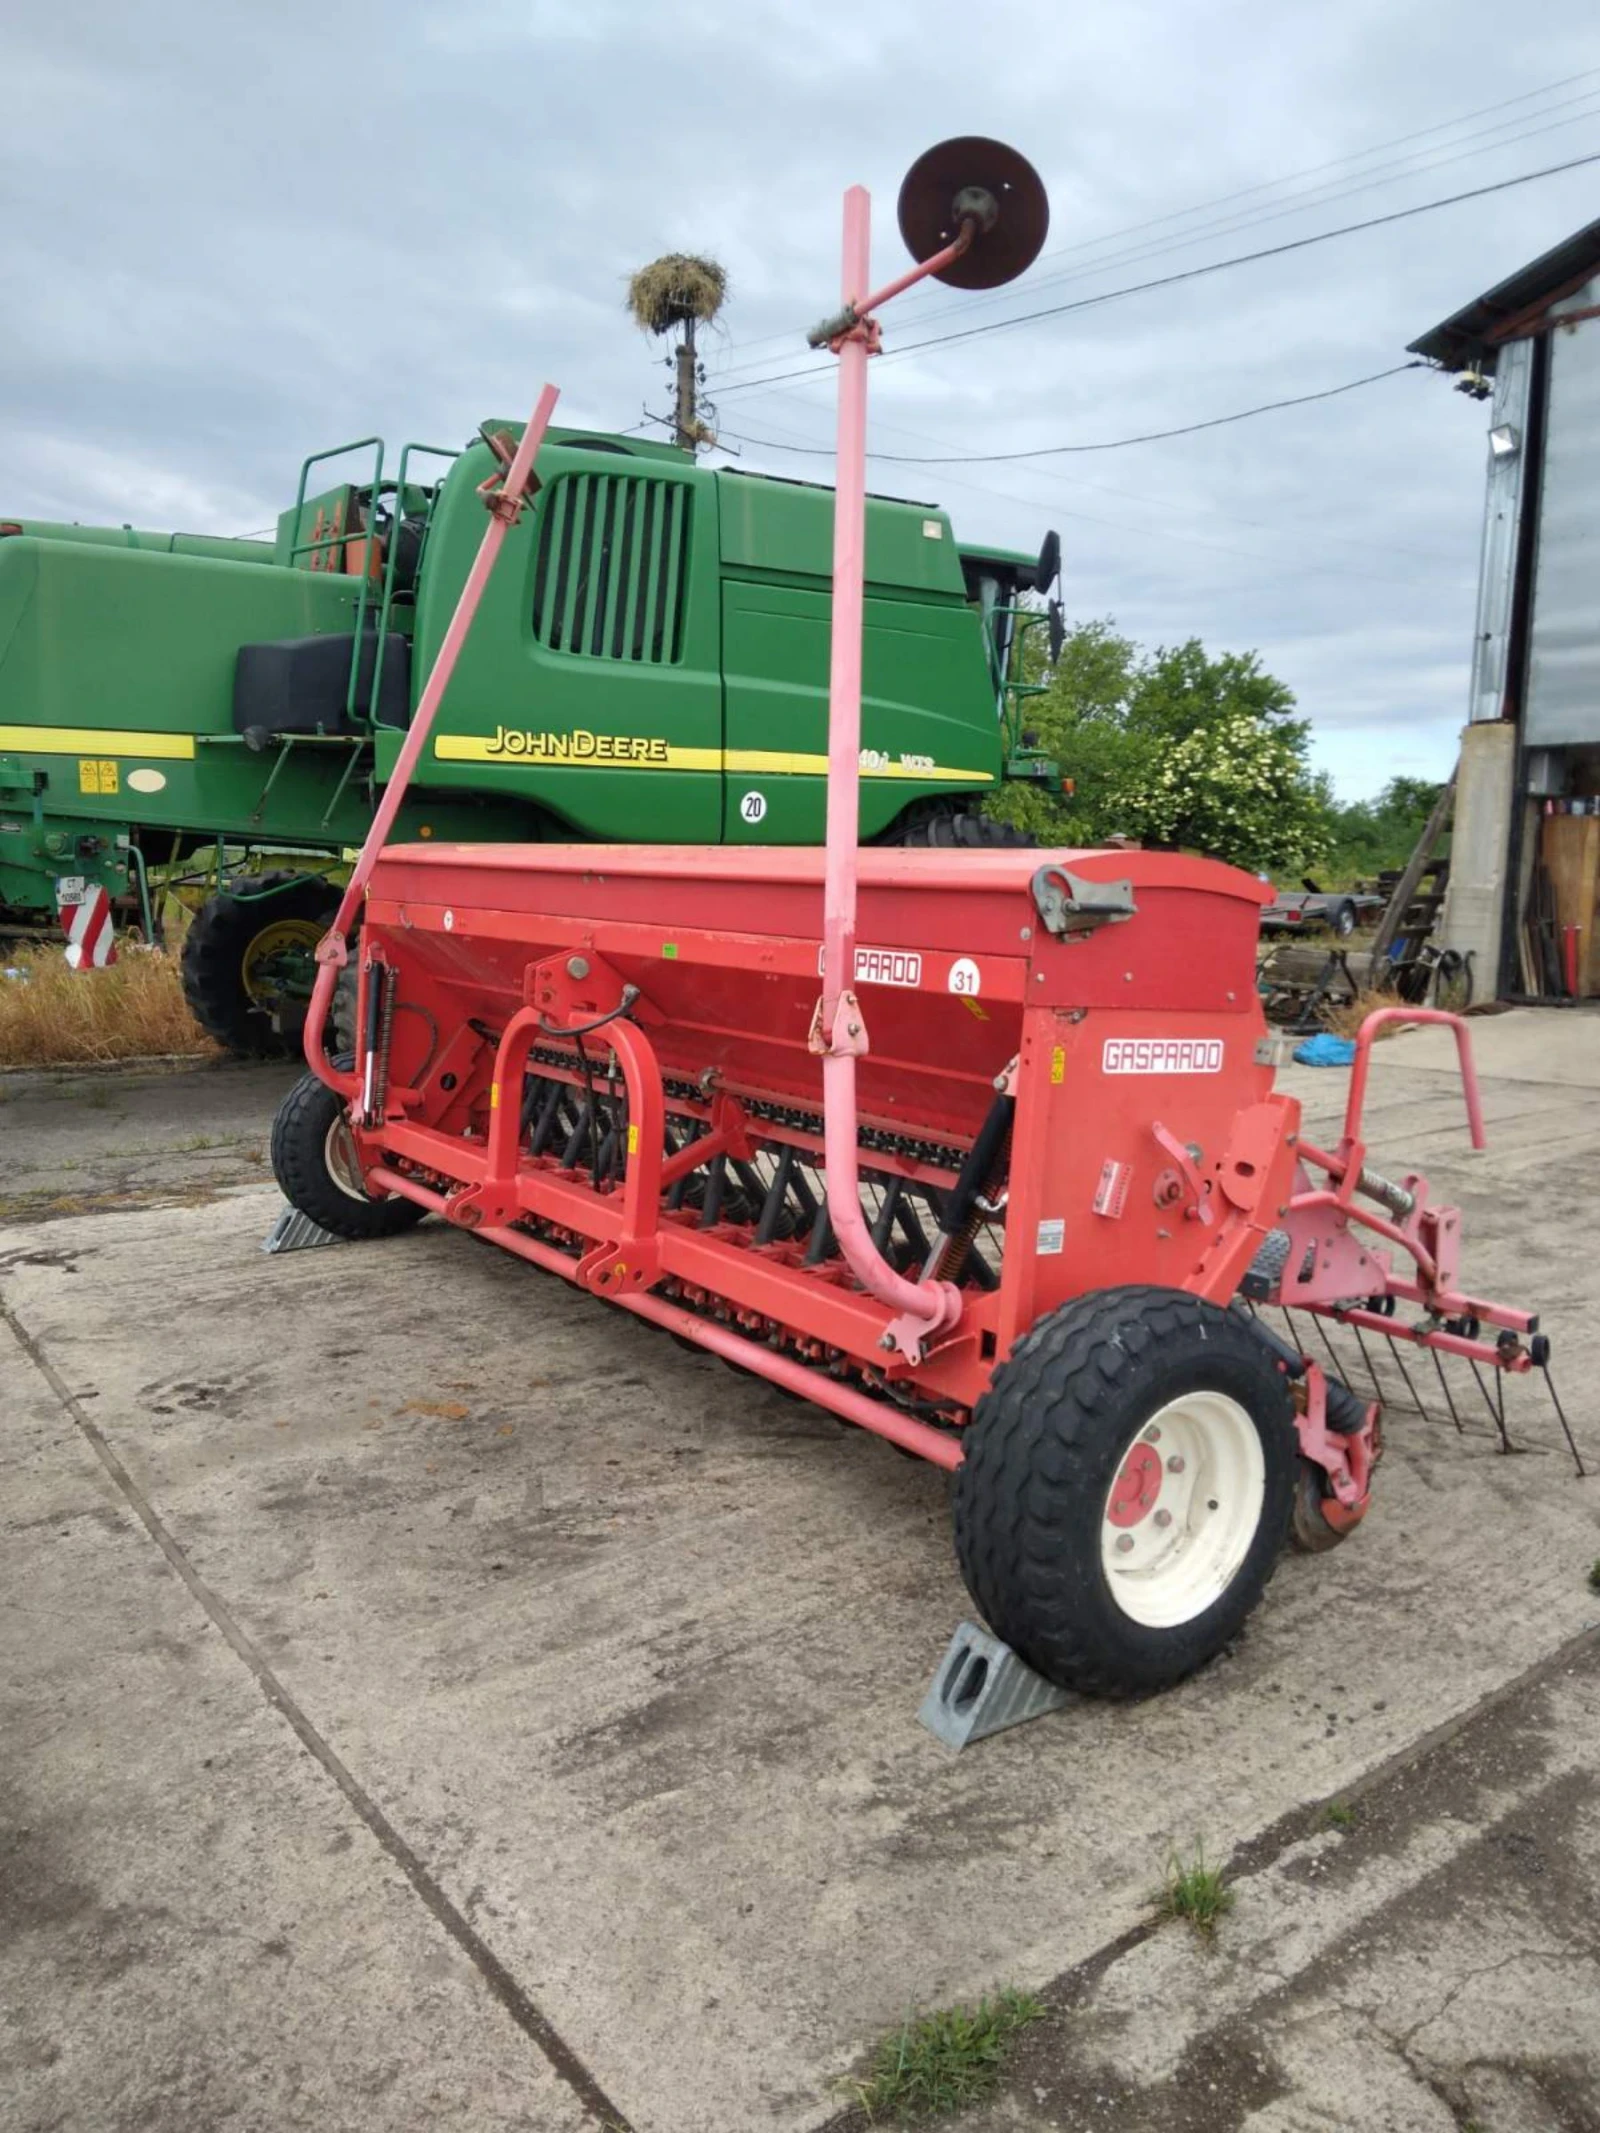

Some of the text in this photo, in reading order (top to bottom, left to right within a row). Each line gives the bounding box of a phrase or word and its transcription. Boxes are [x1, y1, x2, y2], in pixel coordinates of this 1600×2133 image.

[486, 725, 669, 761] JOHN DEERE
[745, 797, 762, 818] 20
[821, 949, 919, 984] PARDO
[954, 971, 974, 992] 31
[1105, 1042, 1221, 1070] GASPARDO
